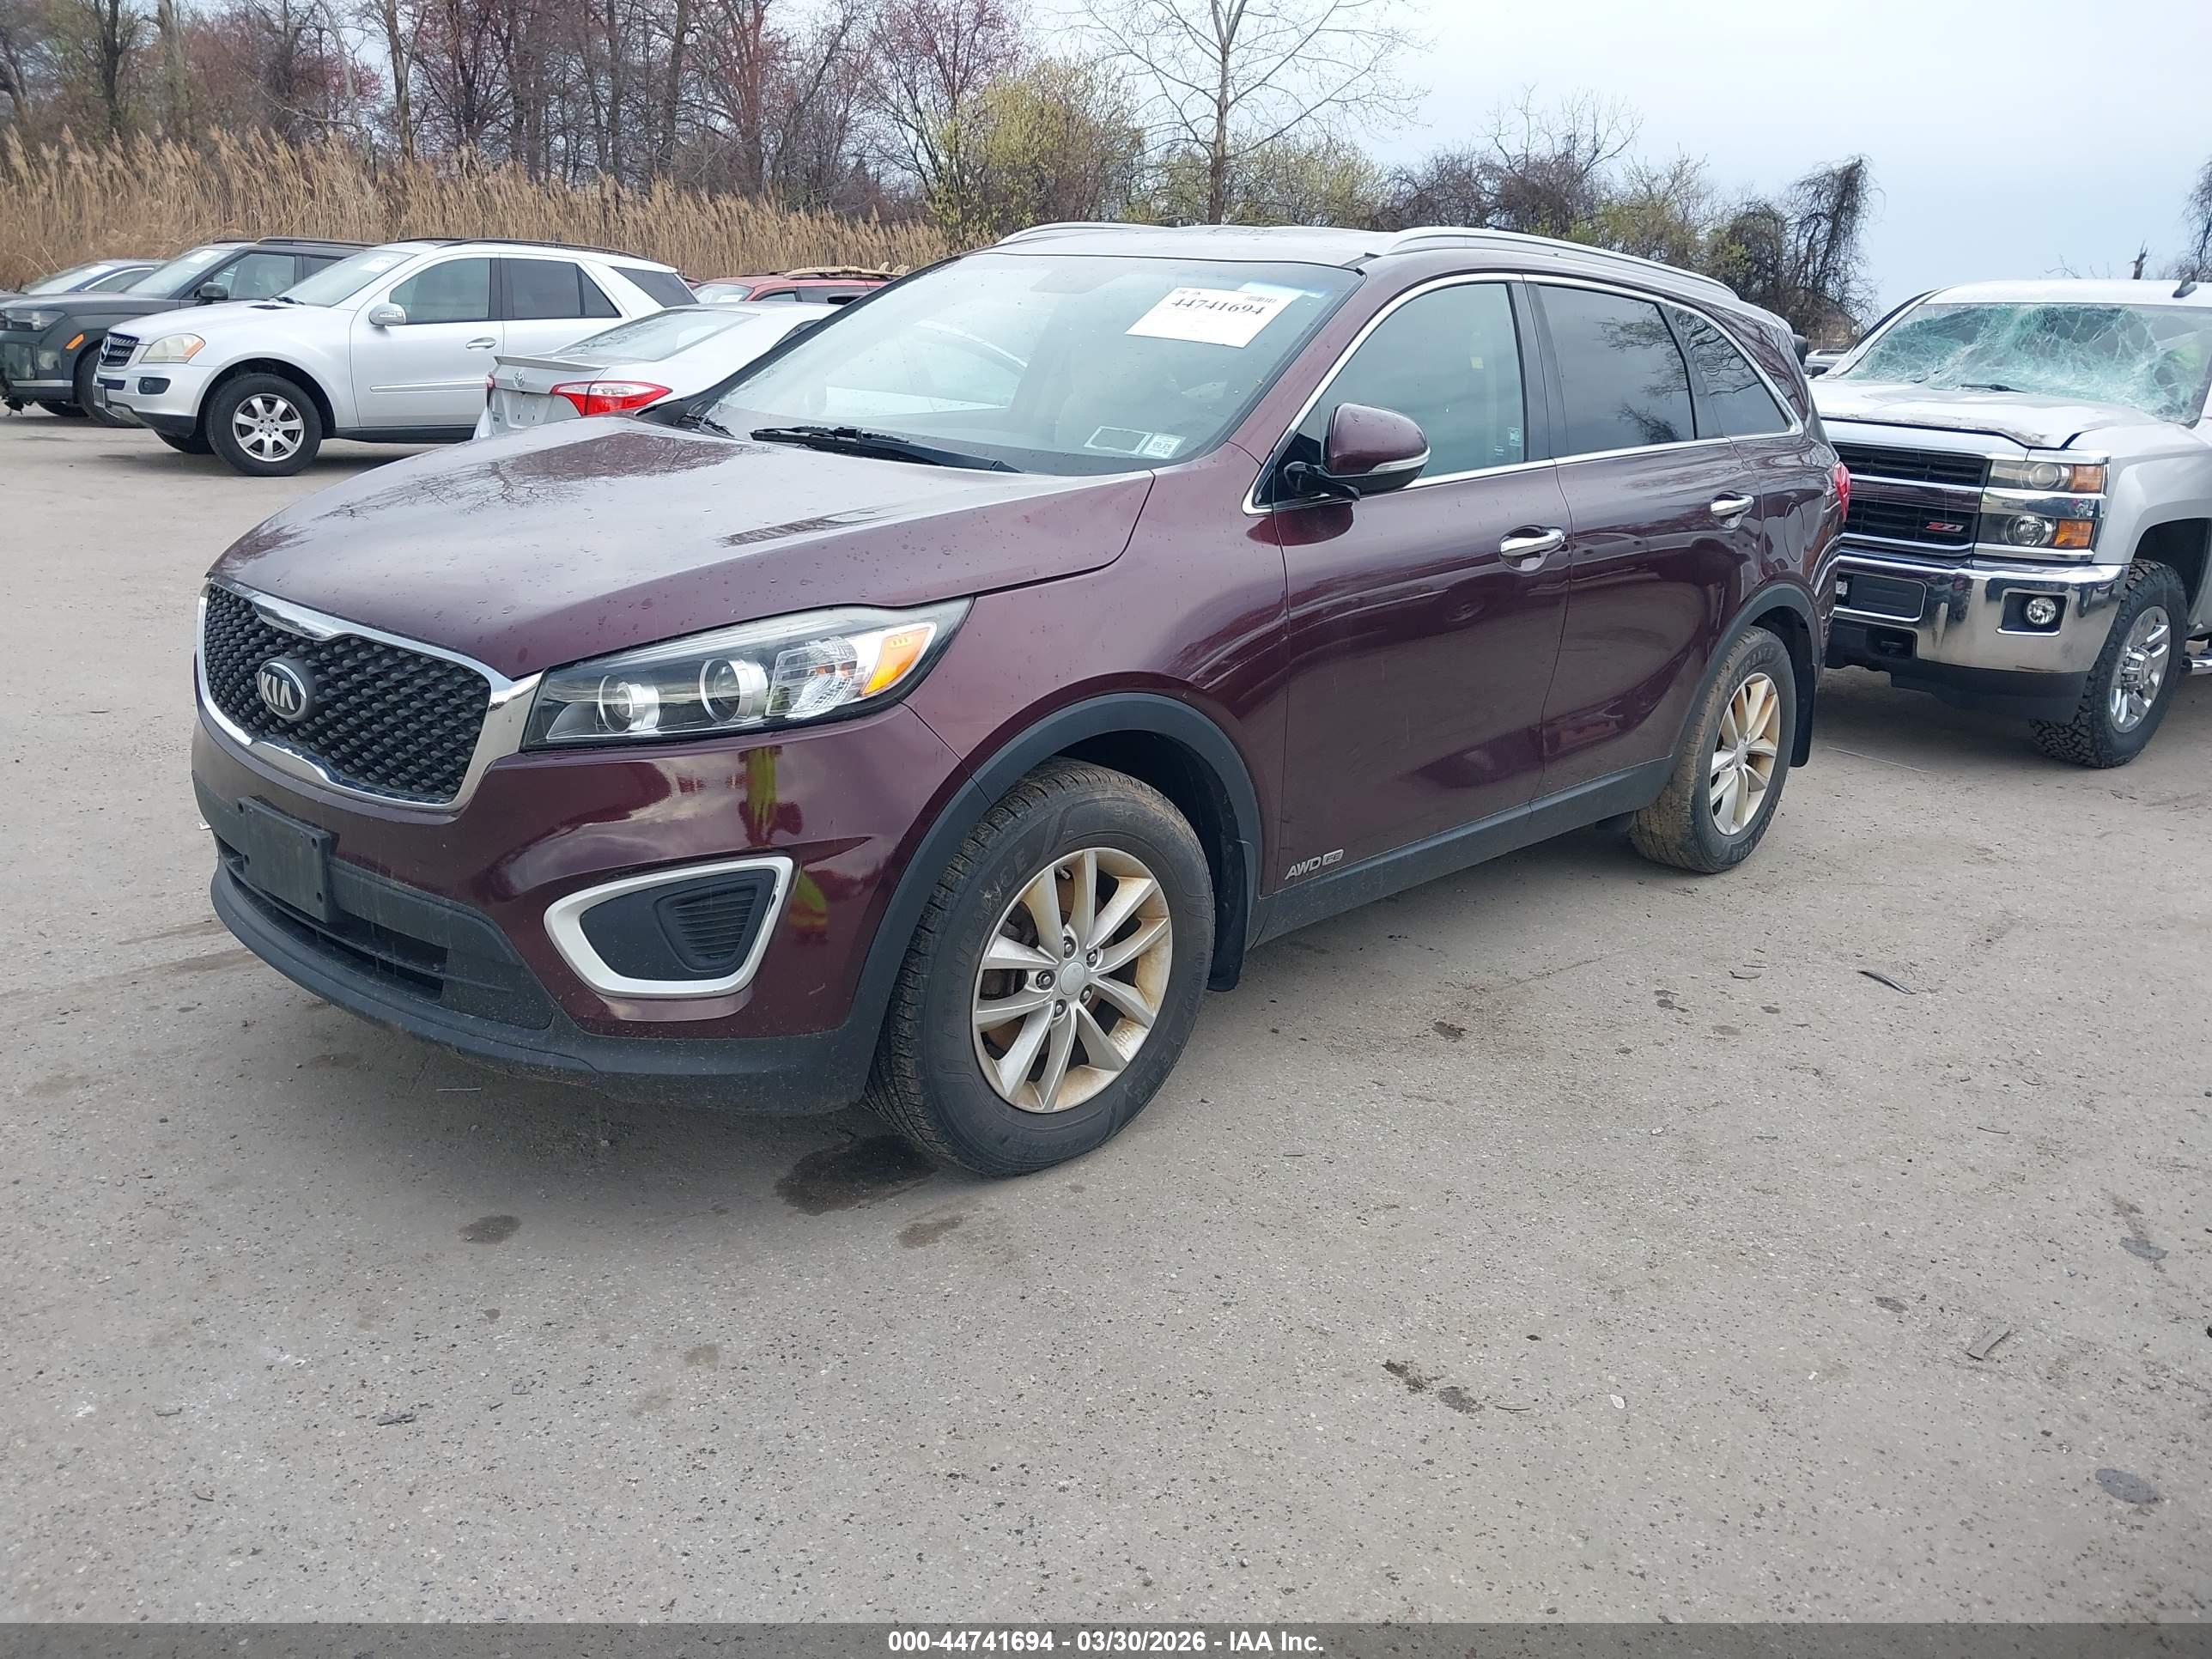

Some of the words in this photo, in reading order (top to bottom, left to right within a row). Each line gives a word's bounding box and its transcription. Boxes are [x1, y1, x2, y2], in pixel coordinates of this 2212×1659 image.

[1170, 297, 1267, 315] 44741694
[260, 671, 295, 711] KIA
[1284, 856, 1322, 881] AWD
